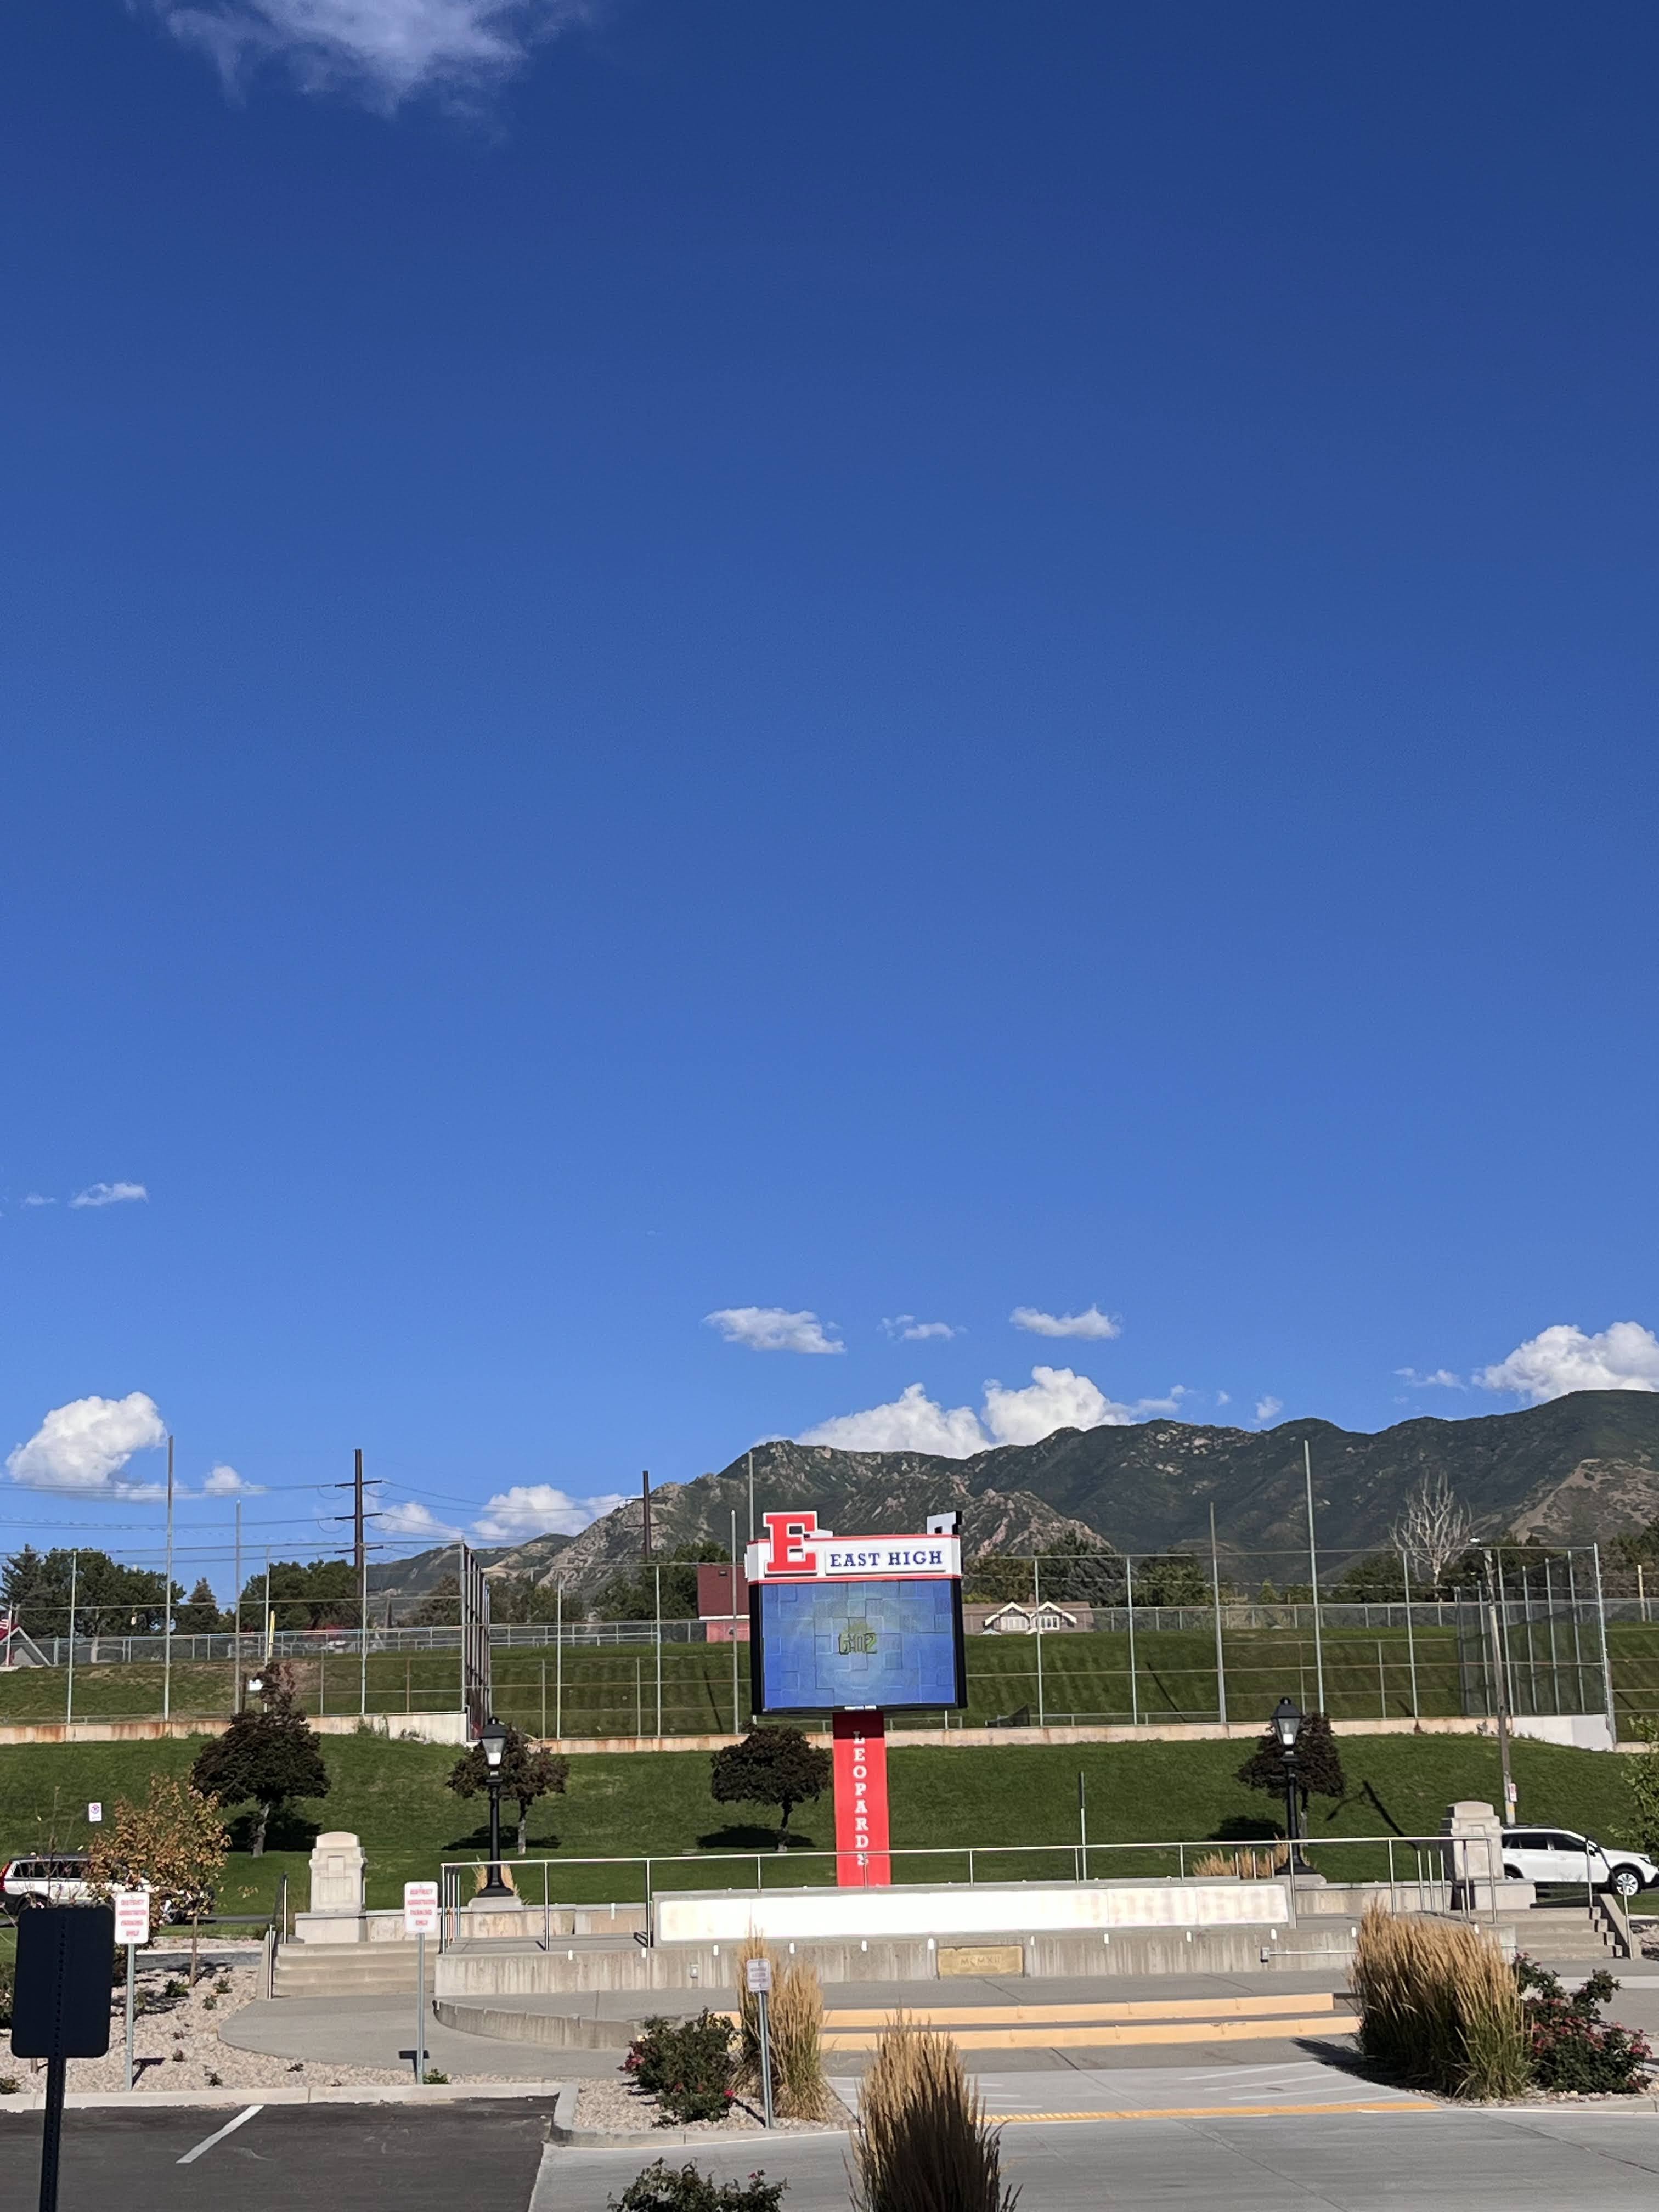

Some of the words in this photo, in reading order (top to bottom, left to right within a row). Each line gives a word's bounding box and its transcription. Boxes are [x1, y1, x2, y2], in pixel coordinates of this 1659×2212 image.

[763, 1511, 817, 1573] E
[830, 1552, 880, 1567] EAST
[888, 1550, 943, 1566] HIGH
